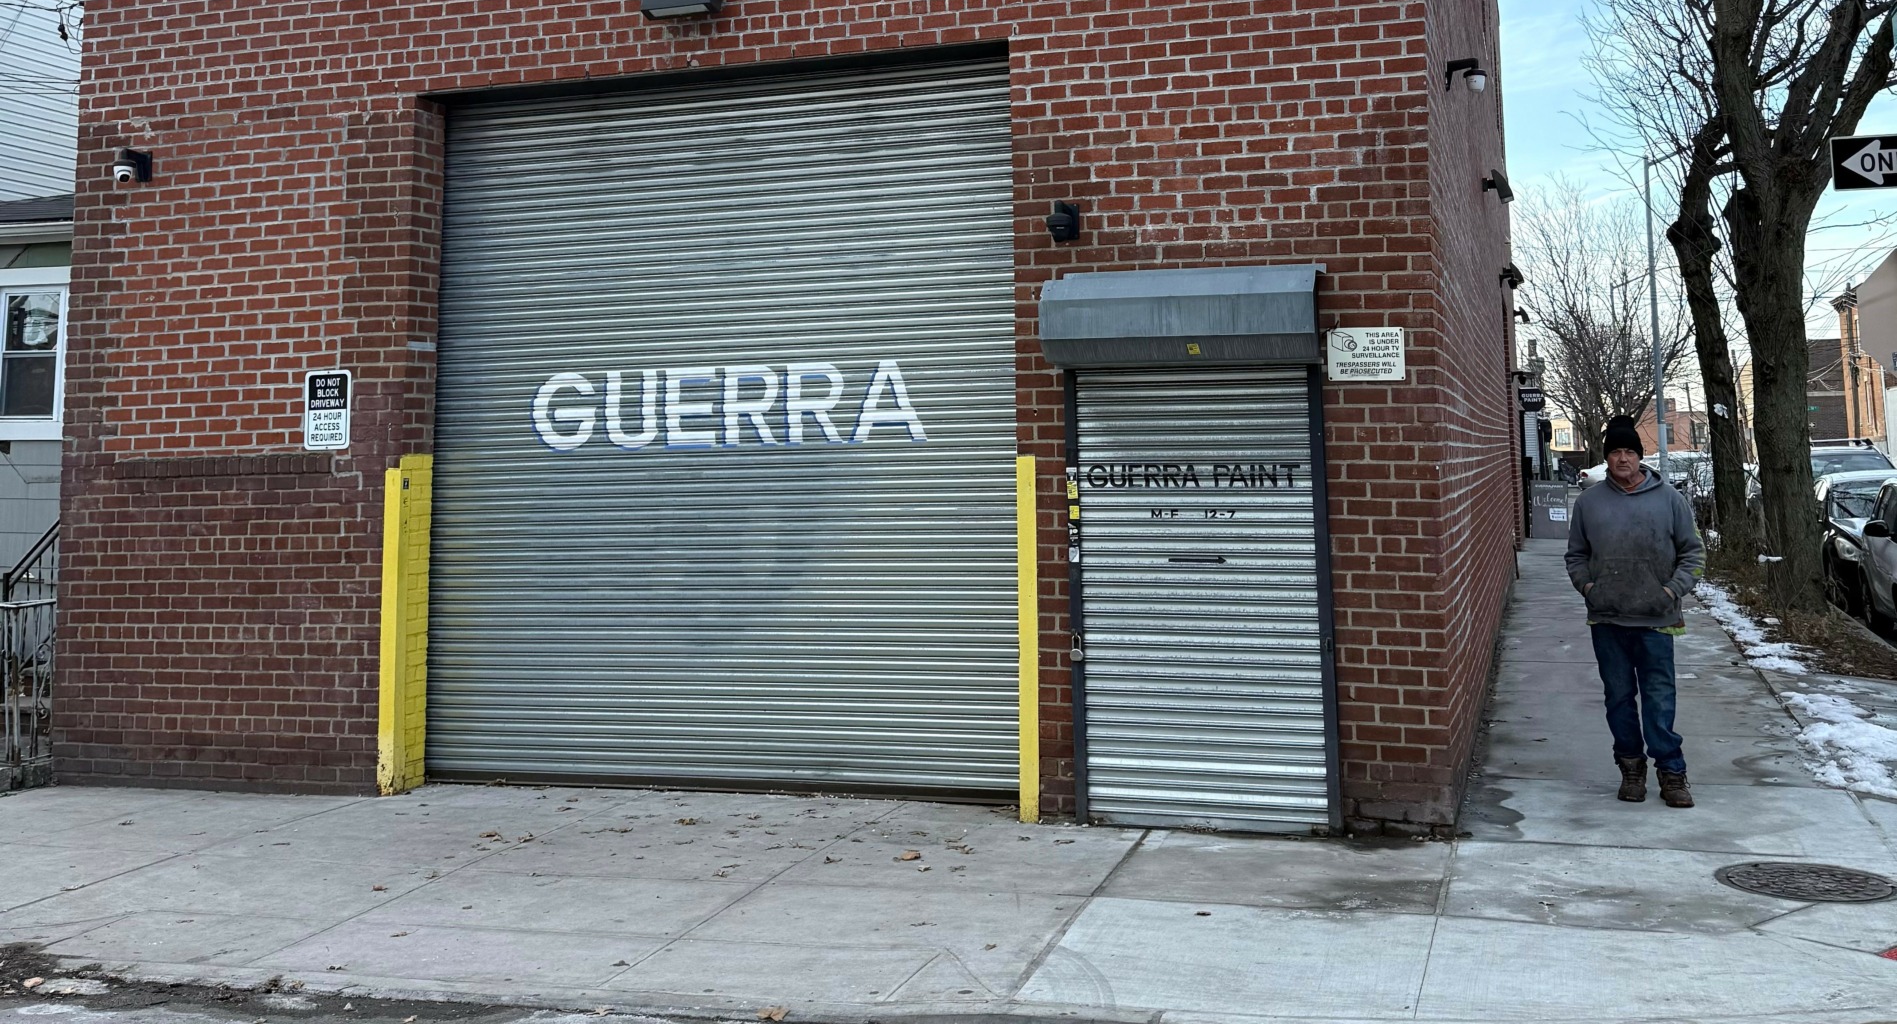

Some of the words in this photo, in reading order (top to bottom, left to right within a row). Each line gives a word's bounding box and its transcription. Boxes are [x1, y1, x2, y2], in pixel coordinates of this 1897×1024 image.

[1861, 152, 1897, 172] ON
[316, 379, 325, 387] DO
[327, 378, 340, 387] NOT
[317, 389, 339, 397] BLOCK
[311, 399, 344, 408] DRIVEWAY
[530, 360, 928, 452] GUERRA
[313, 413, 321, 421] 24
[324, 412, 341, 420] HOUR
[314, 423, 340, 431] ACCESS
[311, 433, 342, 441] REQUIRED
[1087, 464, 1200, 488] GUERRA
[1212, 464, 1300, 488] PAINT
[1151, 509, 1179, 518] M-F
[1204, 510, 1236, 519] 12-7
